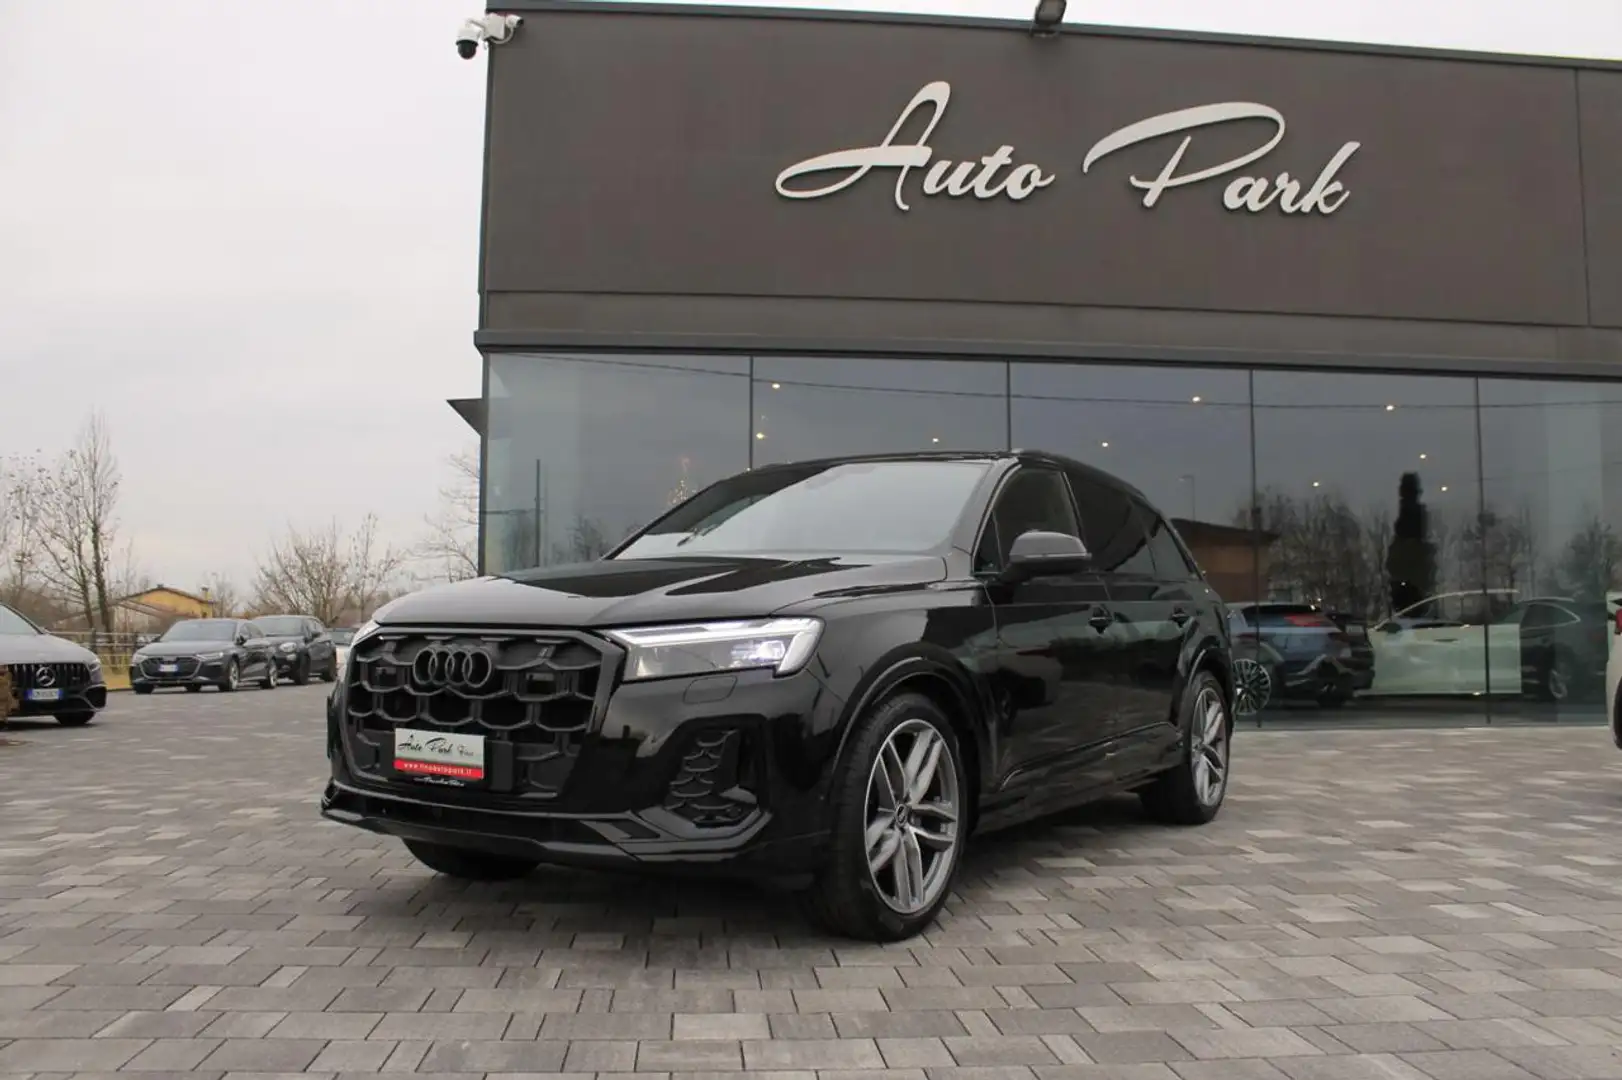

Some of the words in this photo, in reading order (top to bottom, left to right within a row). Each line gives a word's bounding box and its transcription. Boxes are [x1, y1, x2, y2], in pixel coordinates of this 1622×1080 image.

[775, 81, 1055, 212] Auto
[1082, 101, 1361, 216] Park
[397, 732, 423, 753] Auto
[425, 737, 454, 754] Park
